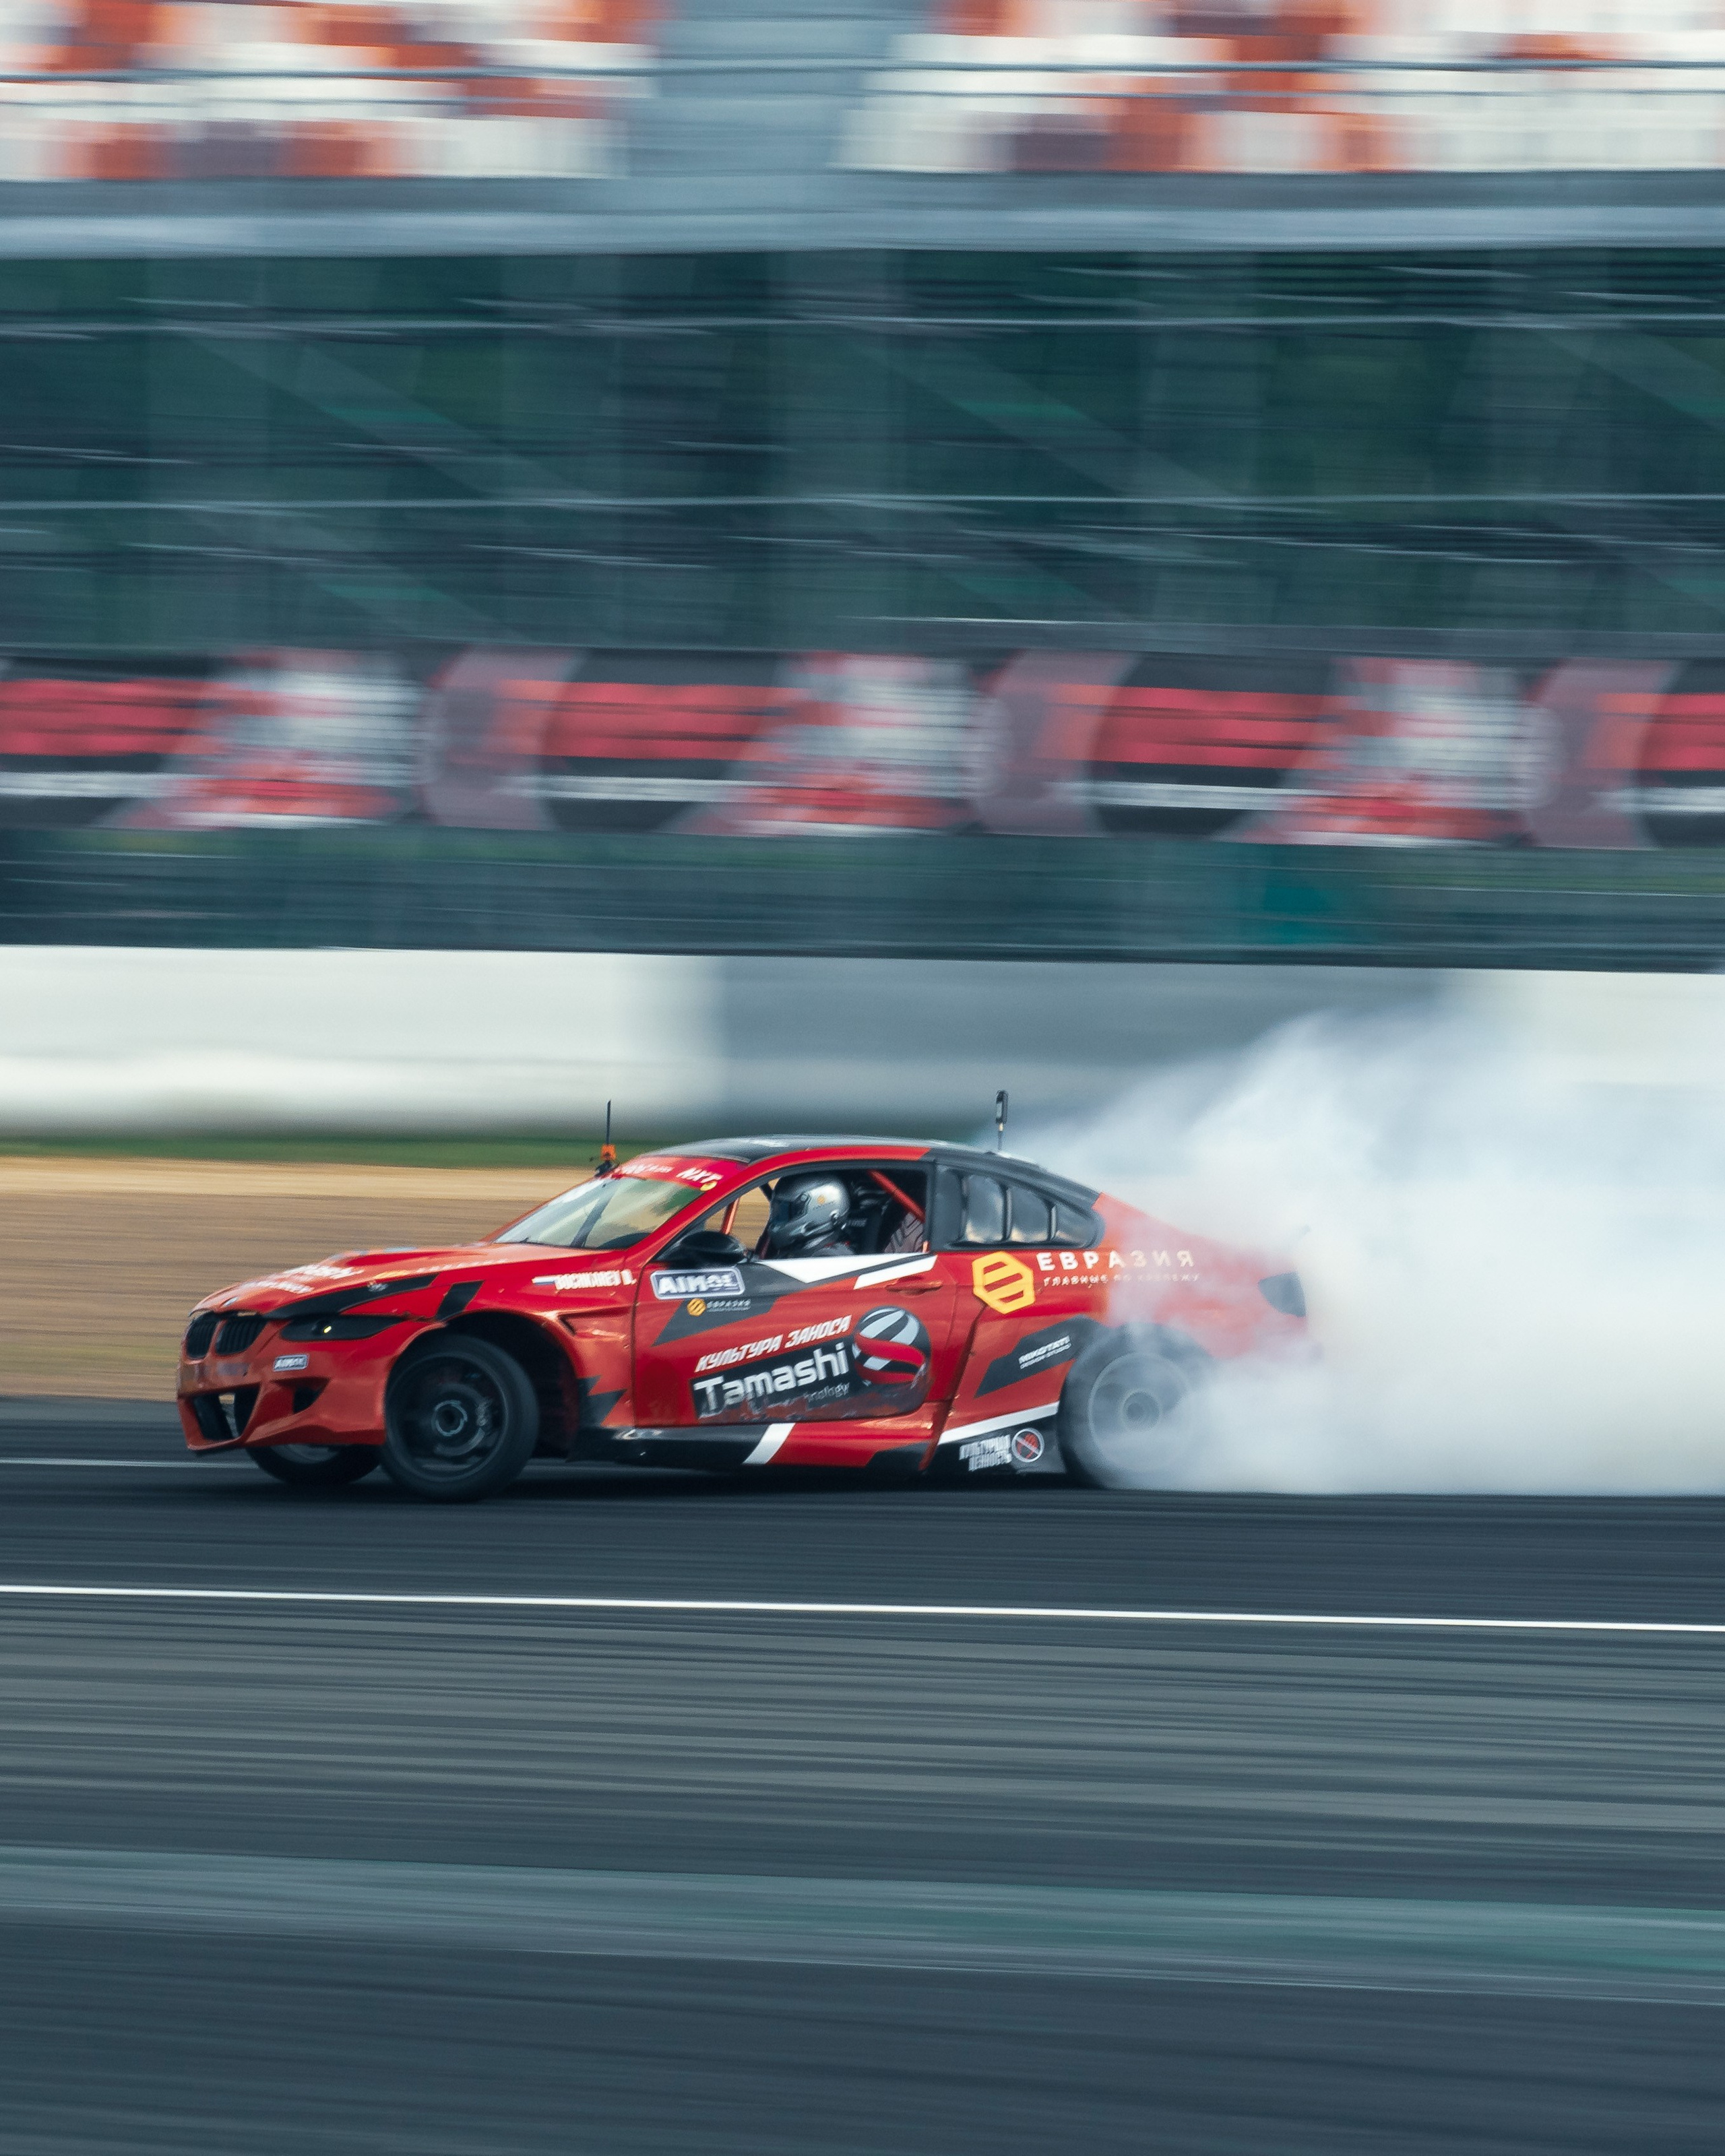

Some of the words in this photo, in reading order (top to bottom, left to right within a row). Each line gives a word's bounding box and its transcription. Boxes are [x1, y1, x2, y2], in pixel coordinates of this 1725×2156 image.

[1036, 1250, 1195, 1271] ЕВРАЗИЯ
[694, 1334, 784, 1373] КУЛЬТУРА
[784, 1314, 852, 1348] ЗАНОСА
[693, 1341, 849, 1411] Tamashi
